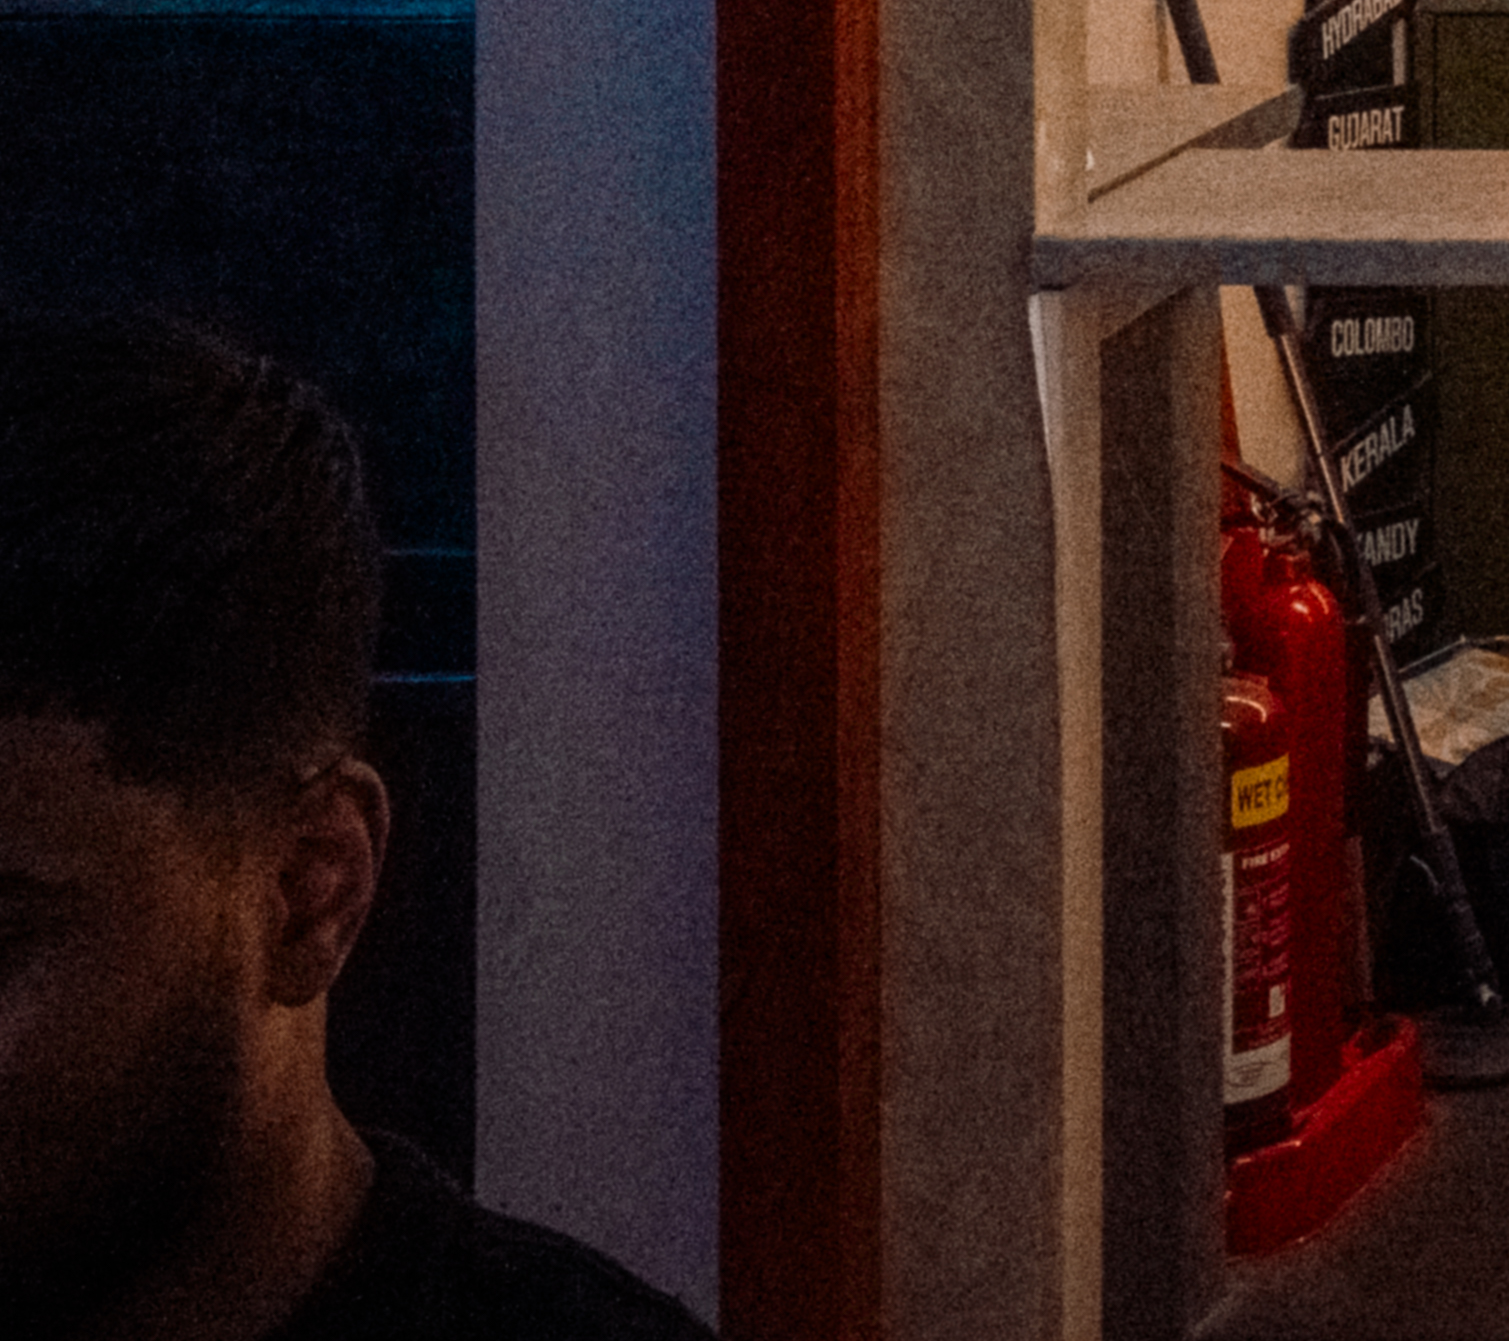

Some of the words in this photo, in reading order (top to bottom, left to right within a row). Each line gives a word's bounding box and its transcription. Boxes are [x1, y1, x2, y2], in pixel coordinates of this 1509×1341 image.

[1329, 106, 1405, 151] GUJARAT
[1331, 316, 1414, 357] COLOMBO
[1341, 404, 1416, 493] KERALA
[1356, 519, 1419, 566] ANDY
[1238, 779, 1271, 812] WET
